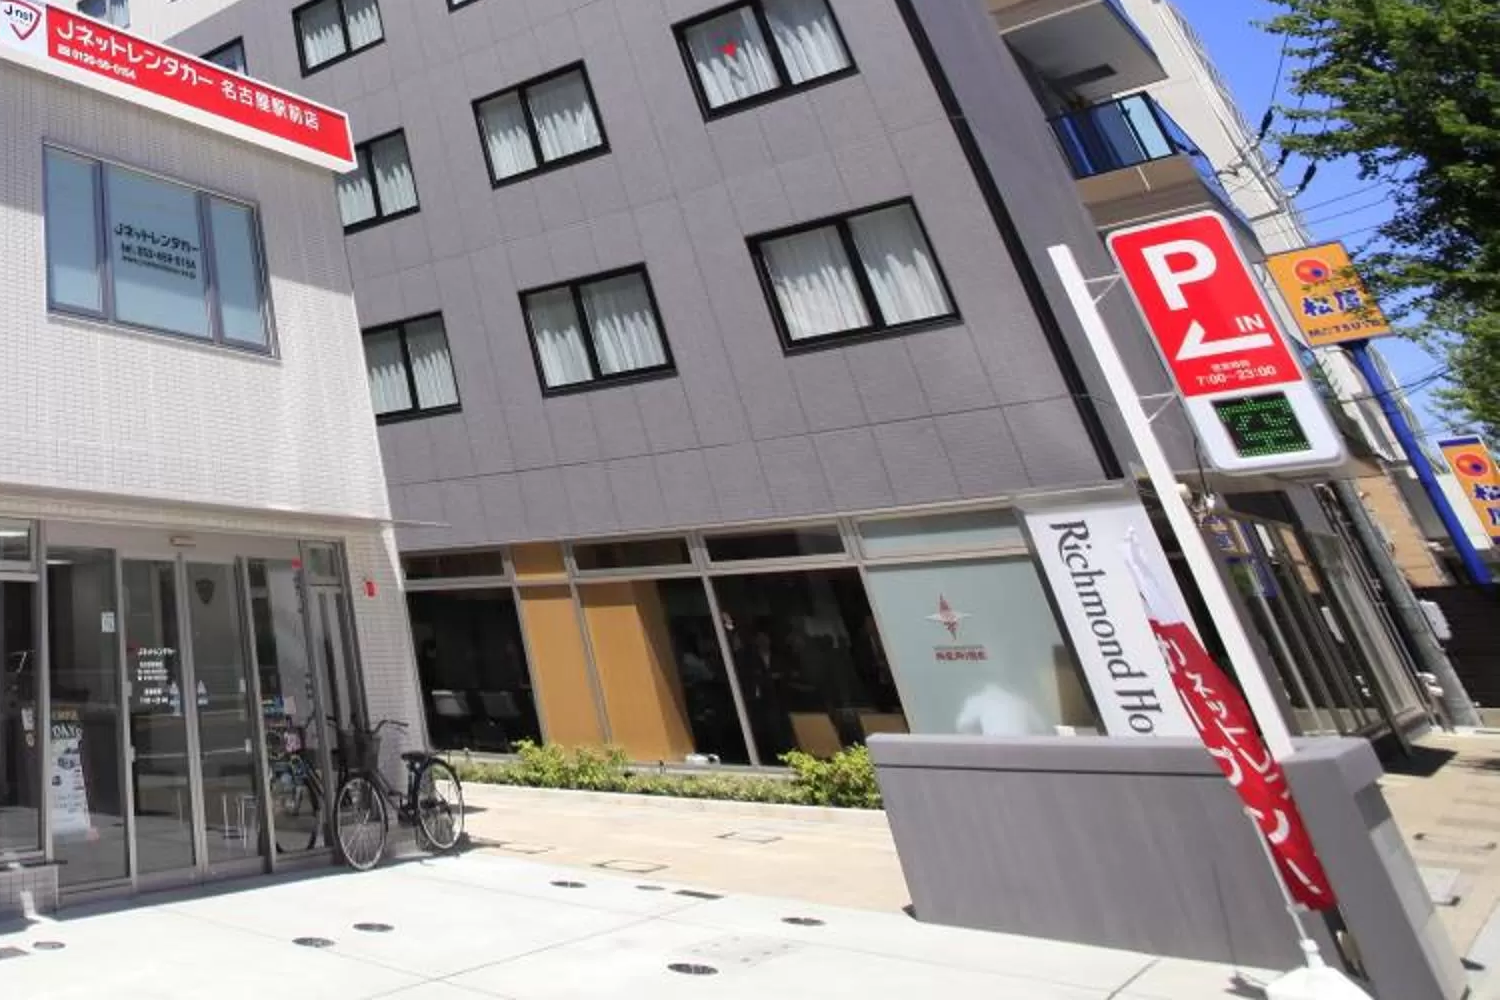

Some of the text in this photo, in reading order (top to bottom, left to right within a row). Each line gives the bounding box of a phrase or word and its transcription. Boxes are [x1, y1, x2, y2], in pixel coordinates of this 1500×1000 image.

[55, 19, 214, 87] Jネットレンタカー
[1140, 239, 1218, 312] P
[1235, 313, 1266, 333] IN
[1049, 519, 1149, 681] Richmond
